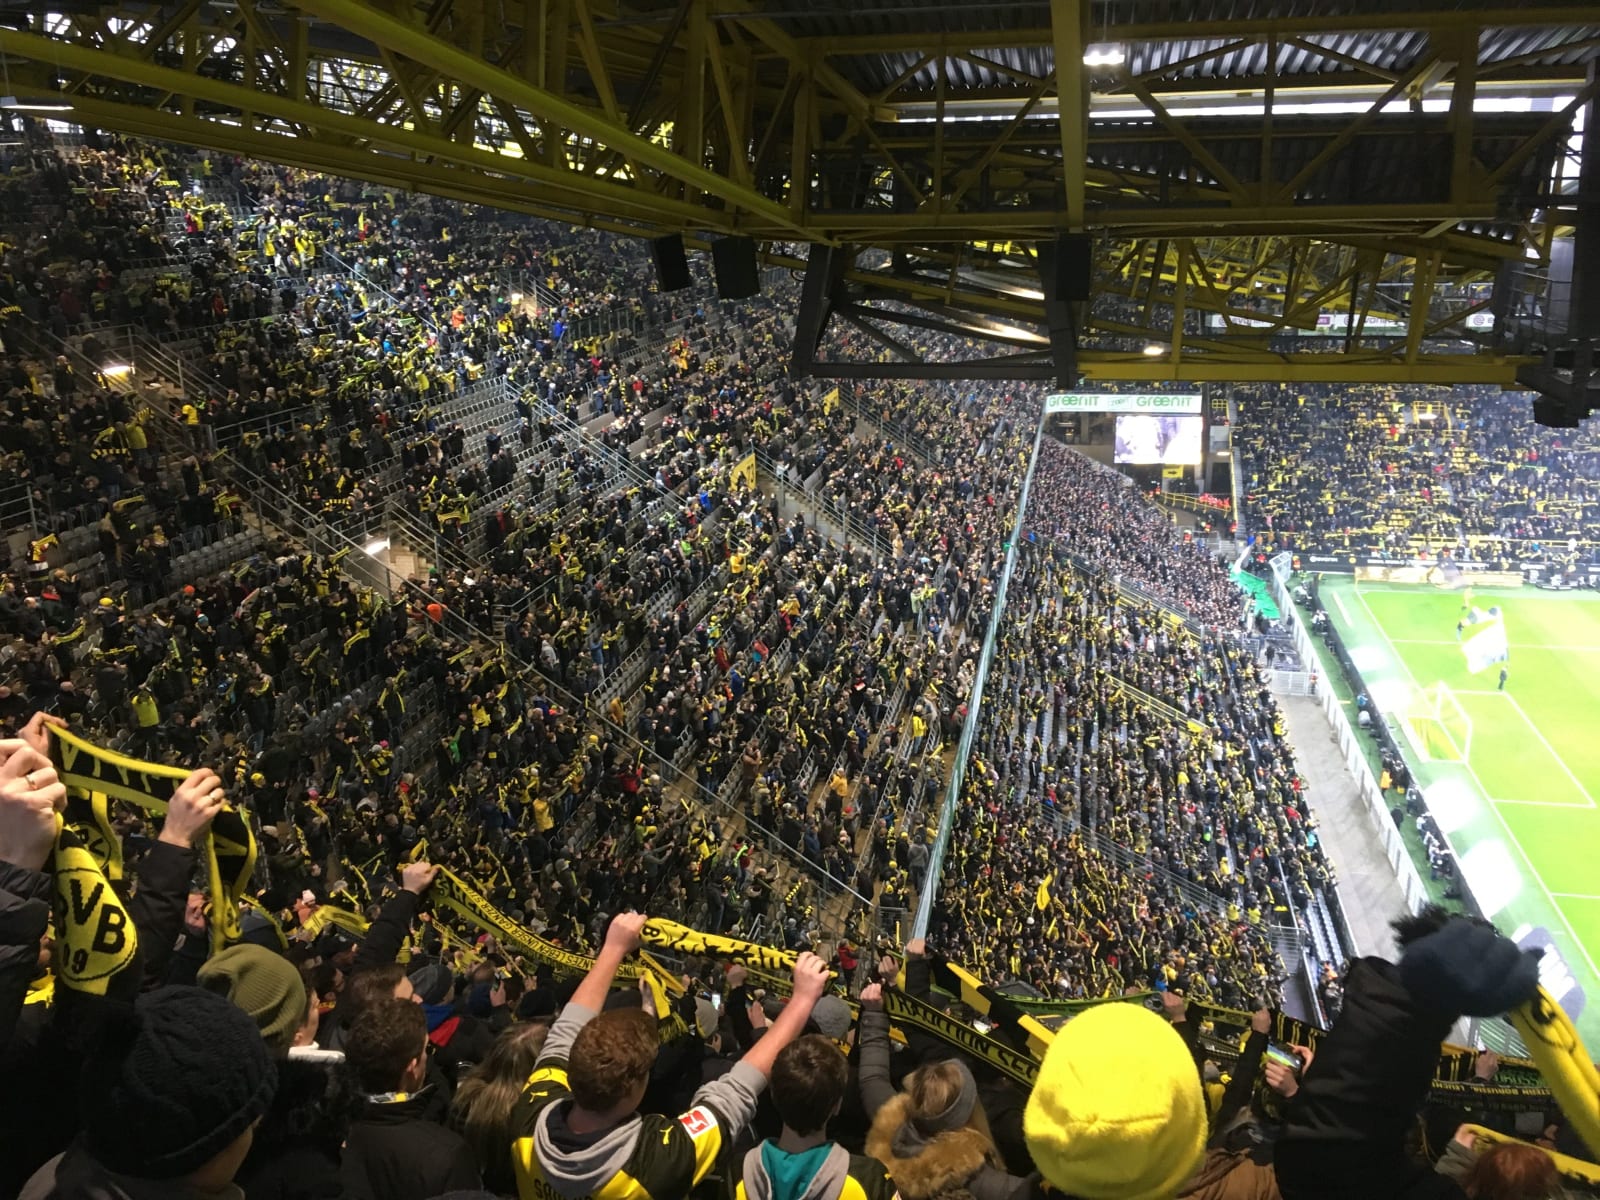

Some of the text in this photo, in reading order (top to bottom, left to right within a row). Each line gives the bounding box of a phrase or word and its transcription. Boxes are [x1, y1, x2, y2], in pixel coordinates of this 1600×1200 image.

[479, 902, 513, 931] GANZER
[510, 926, 539, 949] UNSER
[537, 943, 565, 962] LEBEN
[565, 954, 593, 969] ANZES
